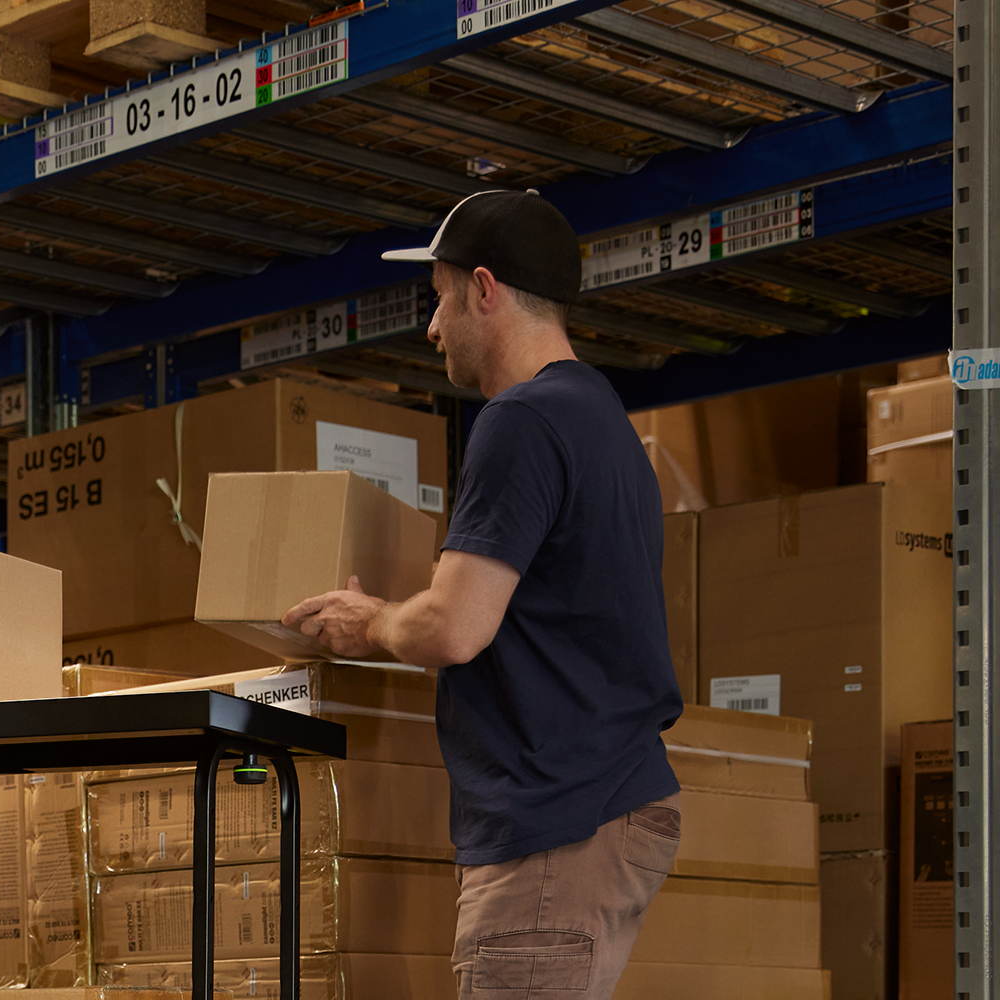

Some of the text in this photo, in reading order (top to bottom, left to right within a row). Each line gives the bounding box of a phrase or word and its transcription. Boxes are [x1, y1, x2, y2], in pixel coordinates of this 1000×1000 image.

[461, 17, 473, 35] 00
[257, 49, 269, 65] 40
[257, 69, 269, 84] 30
[257, 88, 269, 104] 20
[37, 125, 48, 139] 15
[37, 159, 48, 175] 00
[321, 314, 342, 339] 30
[49, 432, 106, 473] 0,155
[18, 478, 103, 520] B 15 ES
